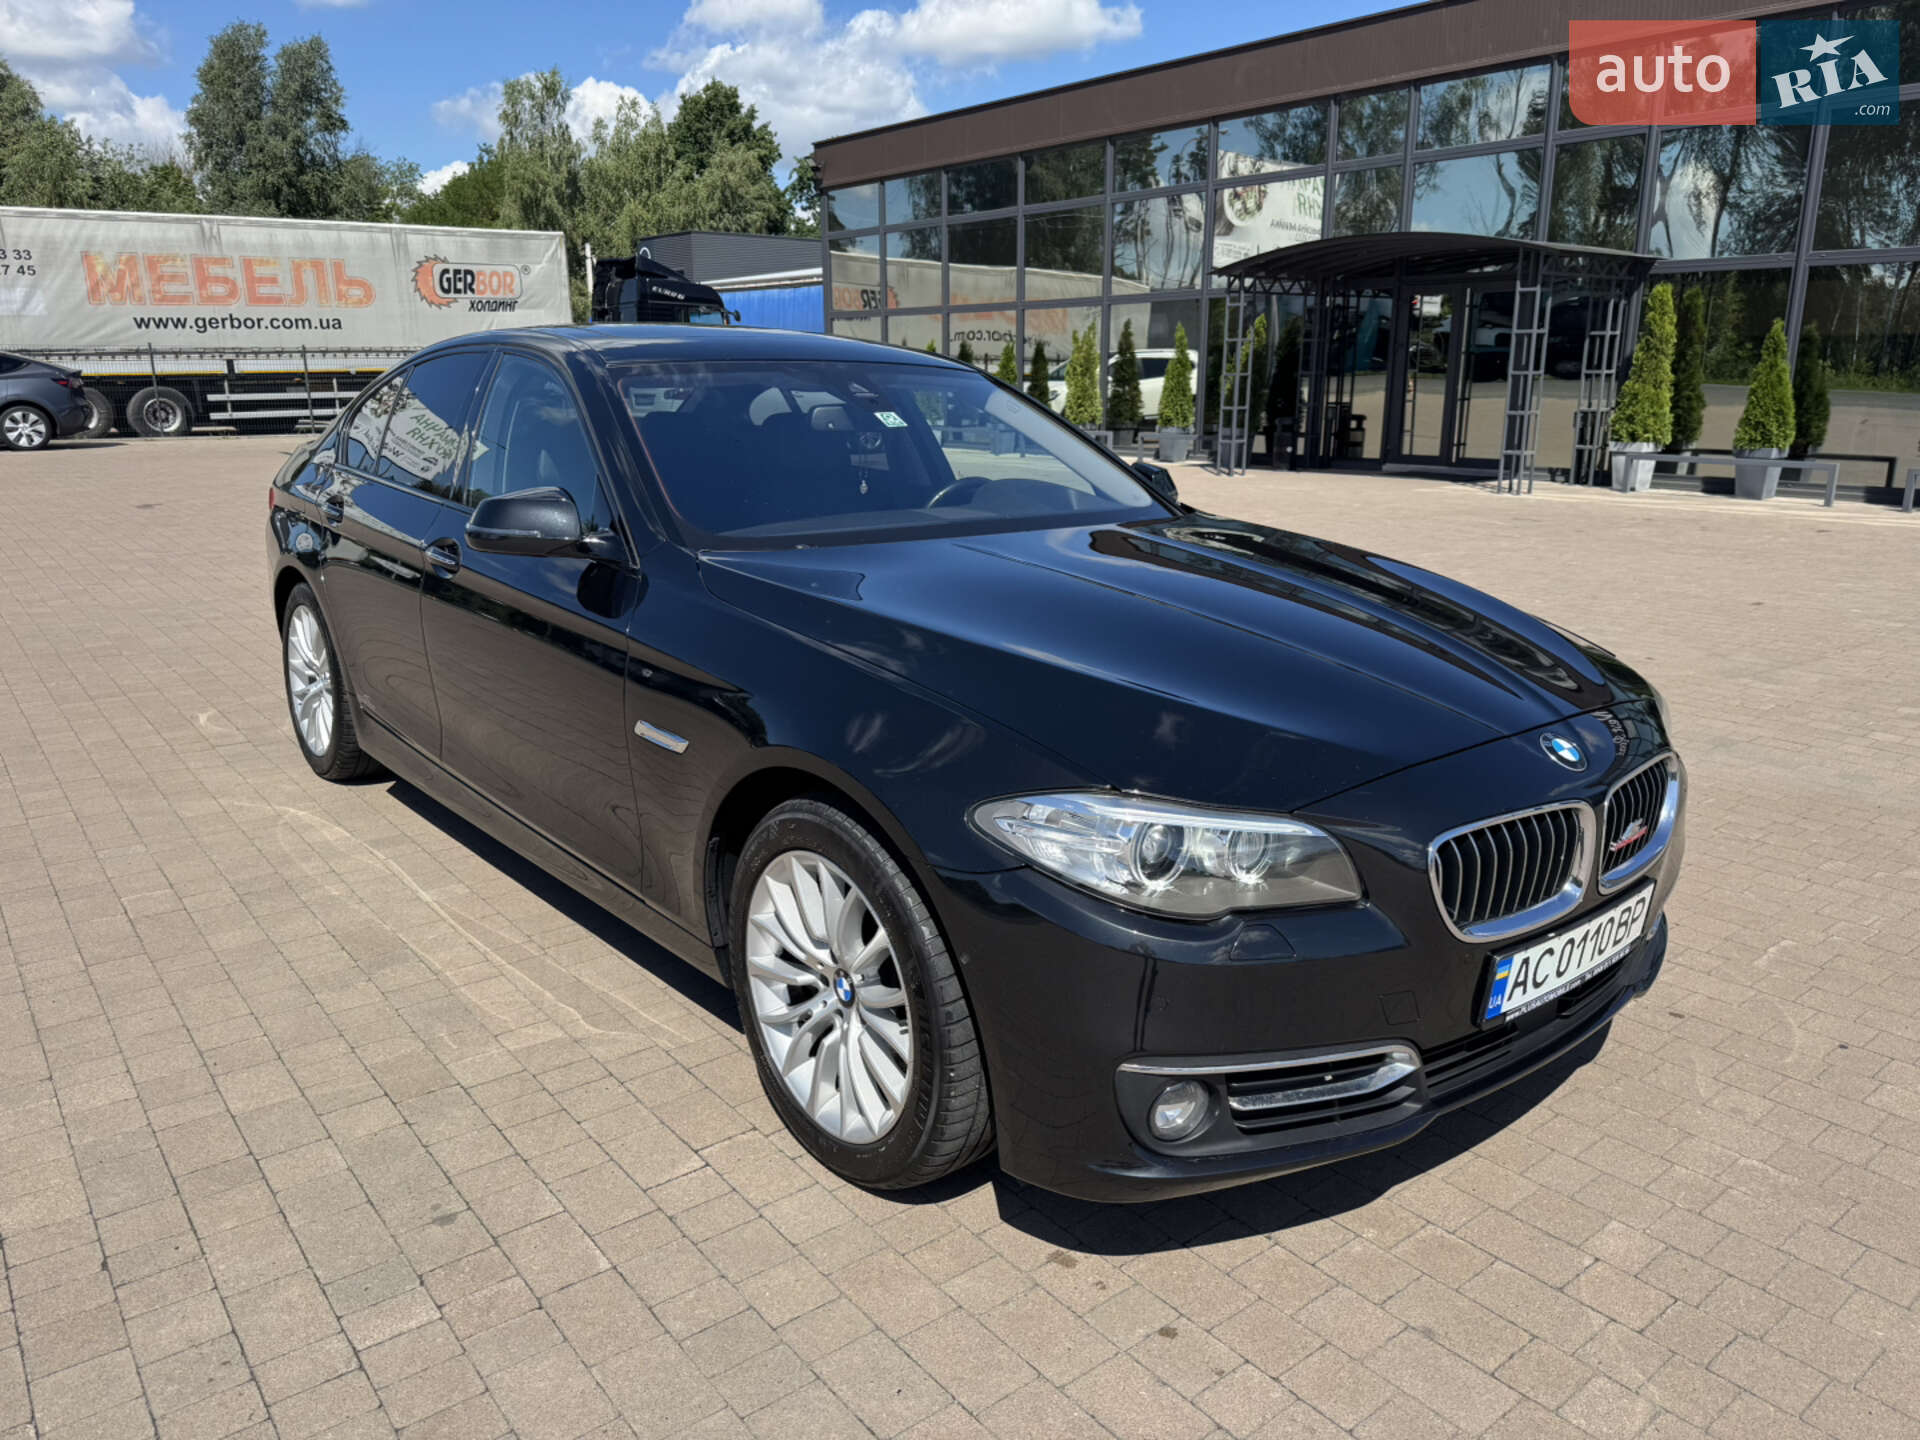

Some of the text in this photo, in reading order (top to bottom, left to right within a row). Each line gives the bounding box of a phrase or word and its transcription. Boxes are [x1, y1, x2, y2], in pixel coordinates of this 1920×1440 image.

[12, 249, 32, 260] 33
[16, 264, 36, 276] 45
[80, 250, 376, 309] МЕБЕЛЬ
[439, 268, 515, 296] GERBOR
[468, 299, 519, 312] ХОЛДИНГ
[133, 313, 343, 333] www.gerbor.com.ua
[1488, 994, 1502, 1009] UA
